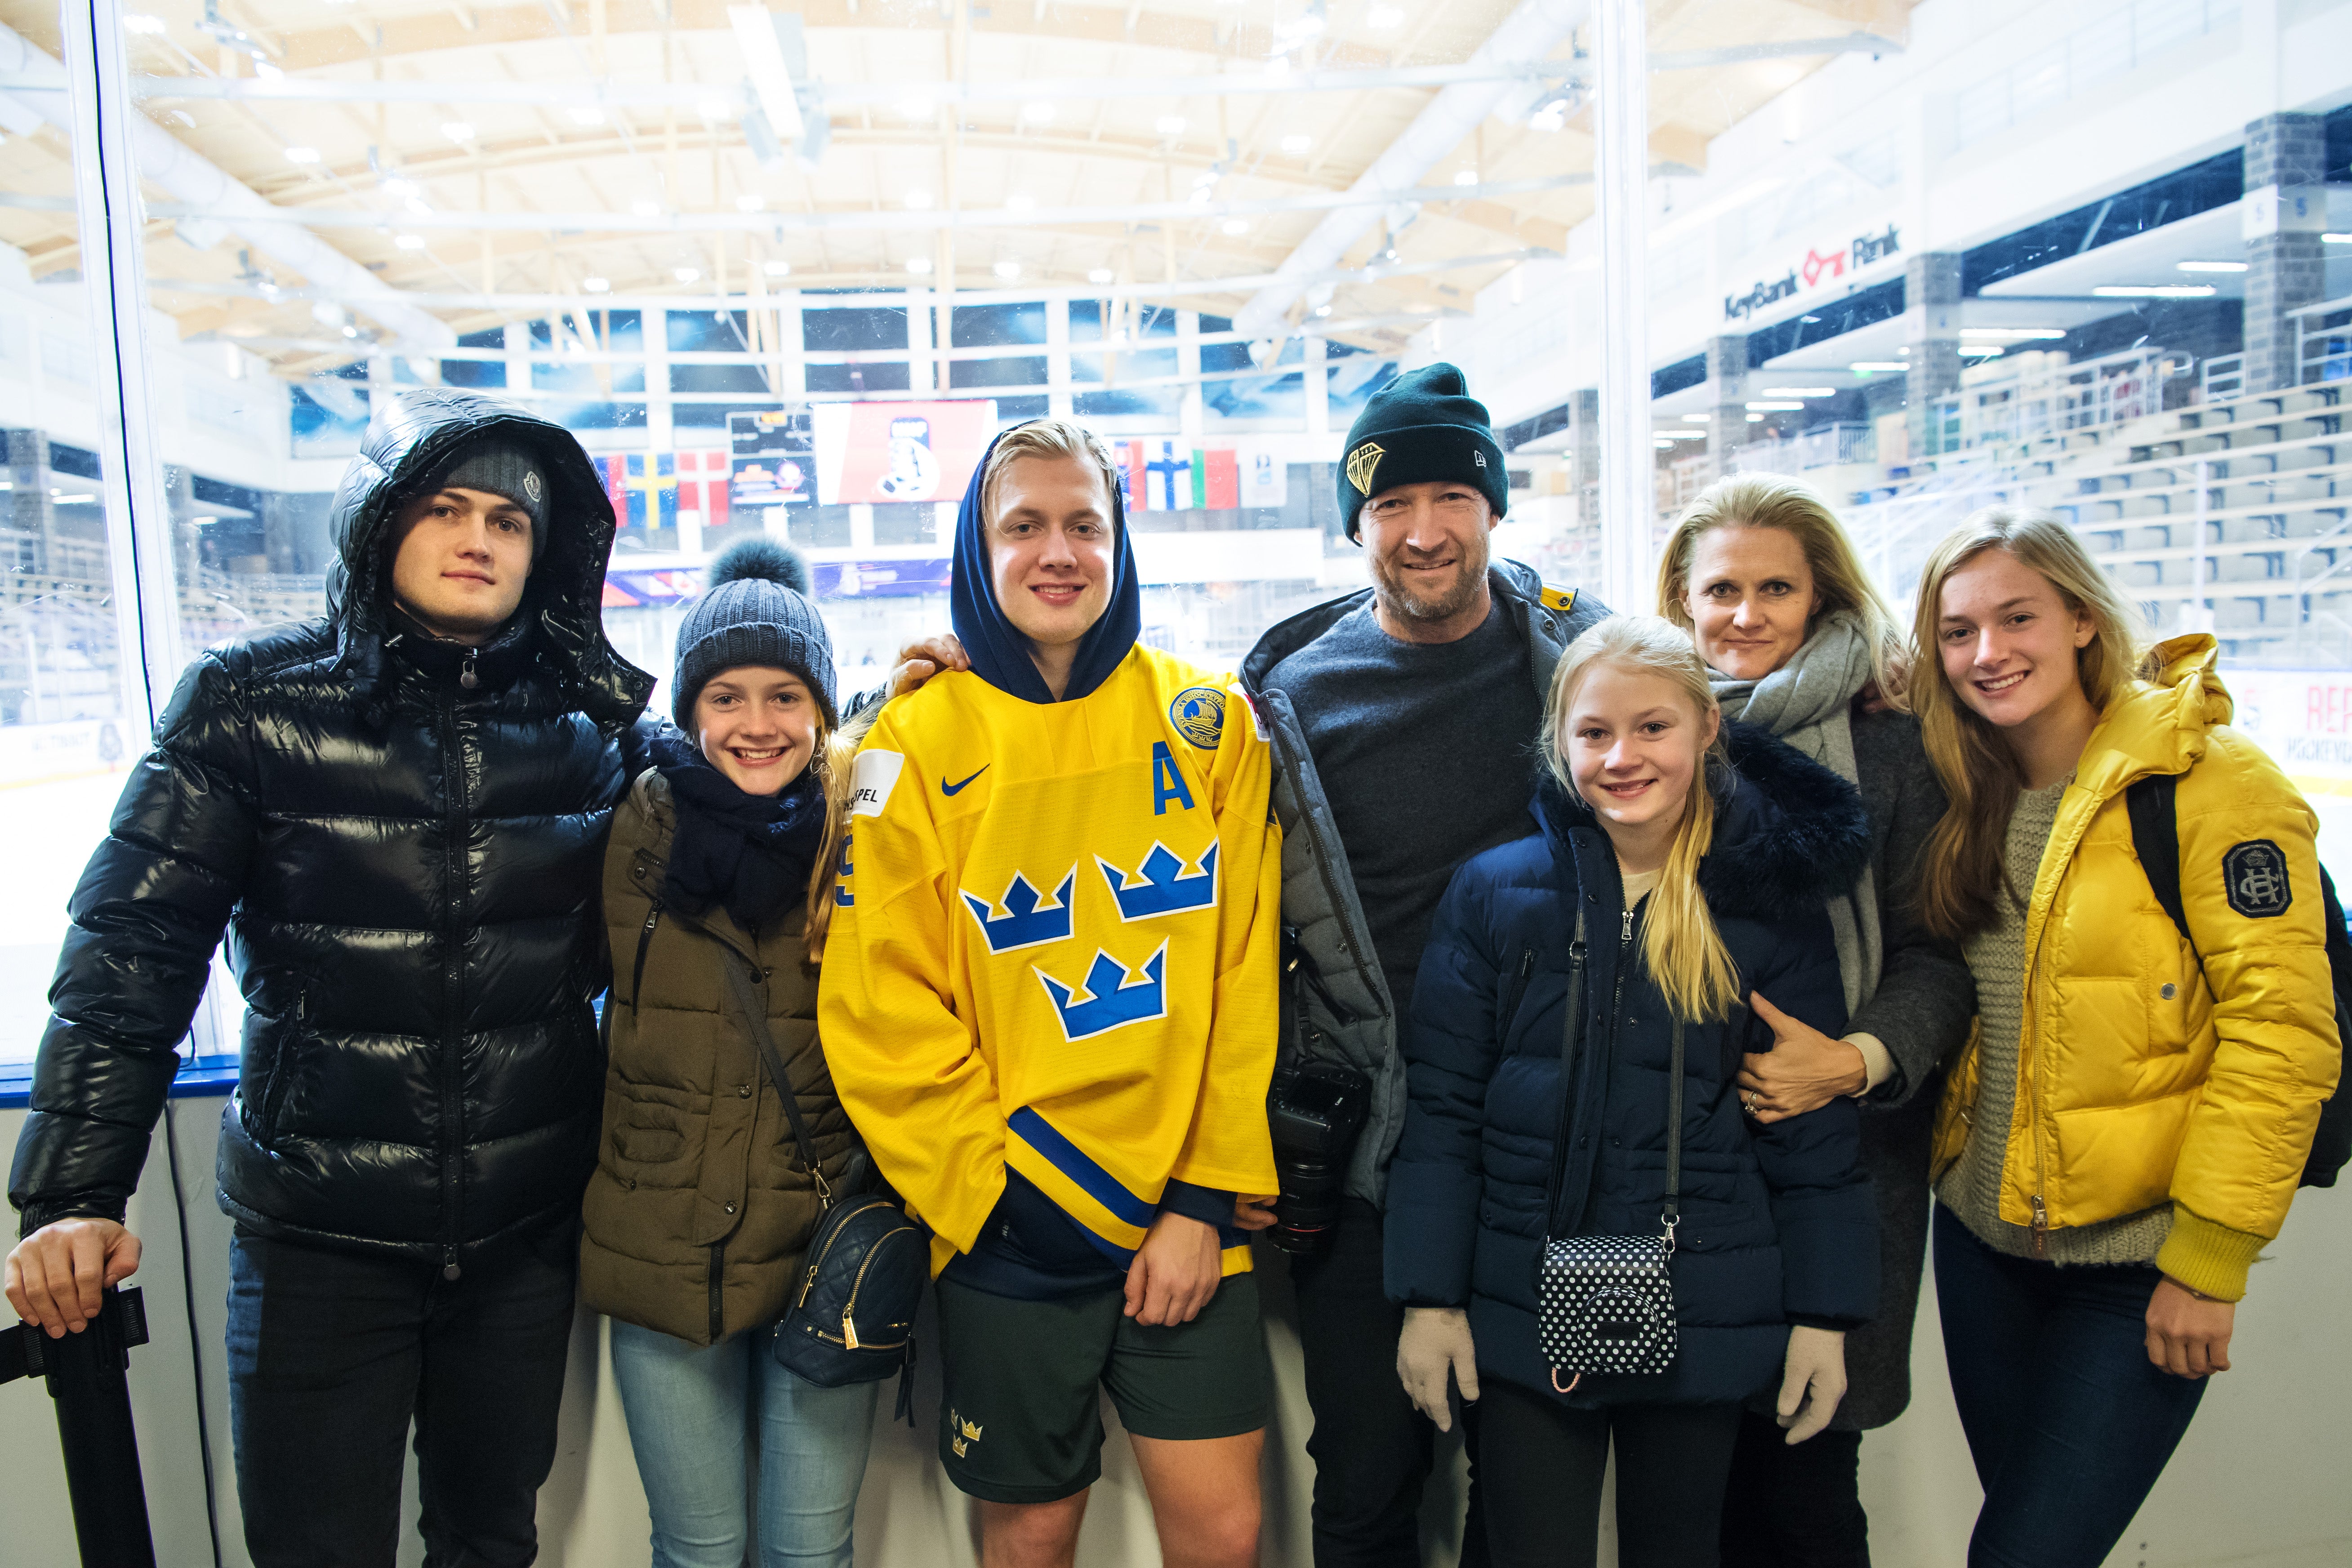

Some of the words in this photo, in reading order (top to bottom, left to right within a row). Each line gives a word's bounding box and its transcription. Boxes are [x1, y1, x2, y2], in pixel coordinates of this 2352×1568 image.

[1725, 269, 1799, 321] KeyBank
[1853, 223, 1900, 269] Rink
[1153, 740, 1195, 815] A
